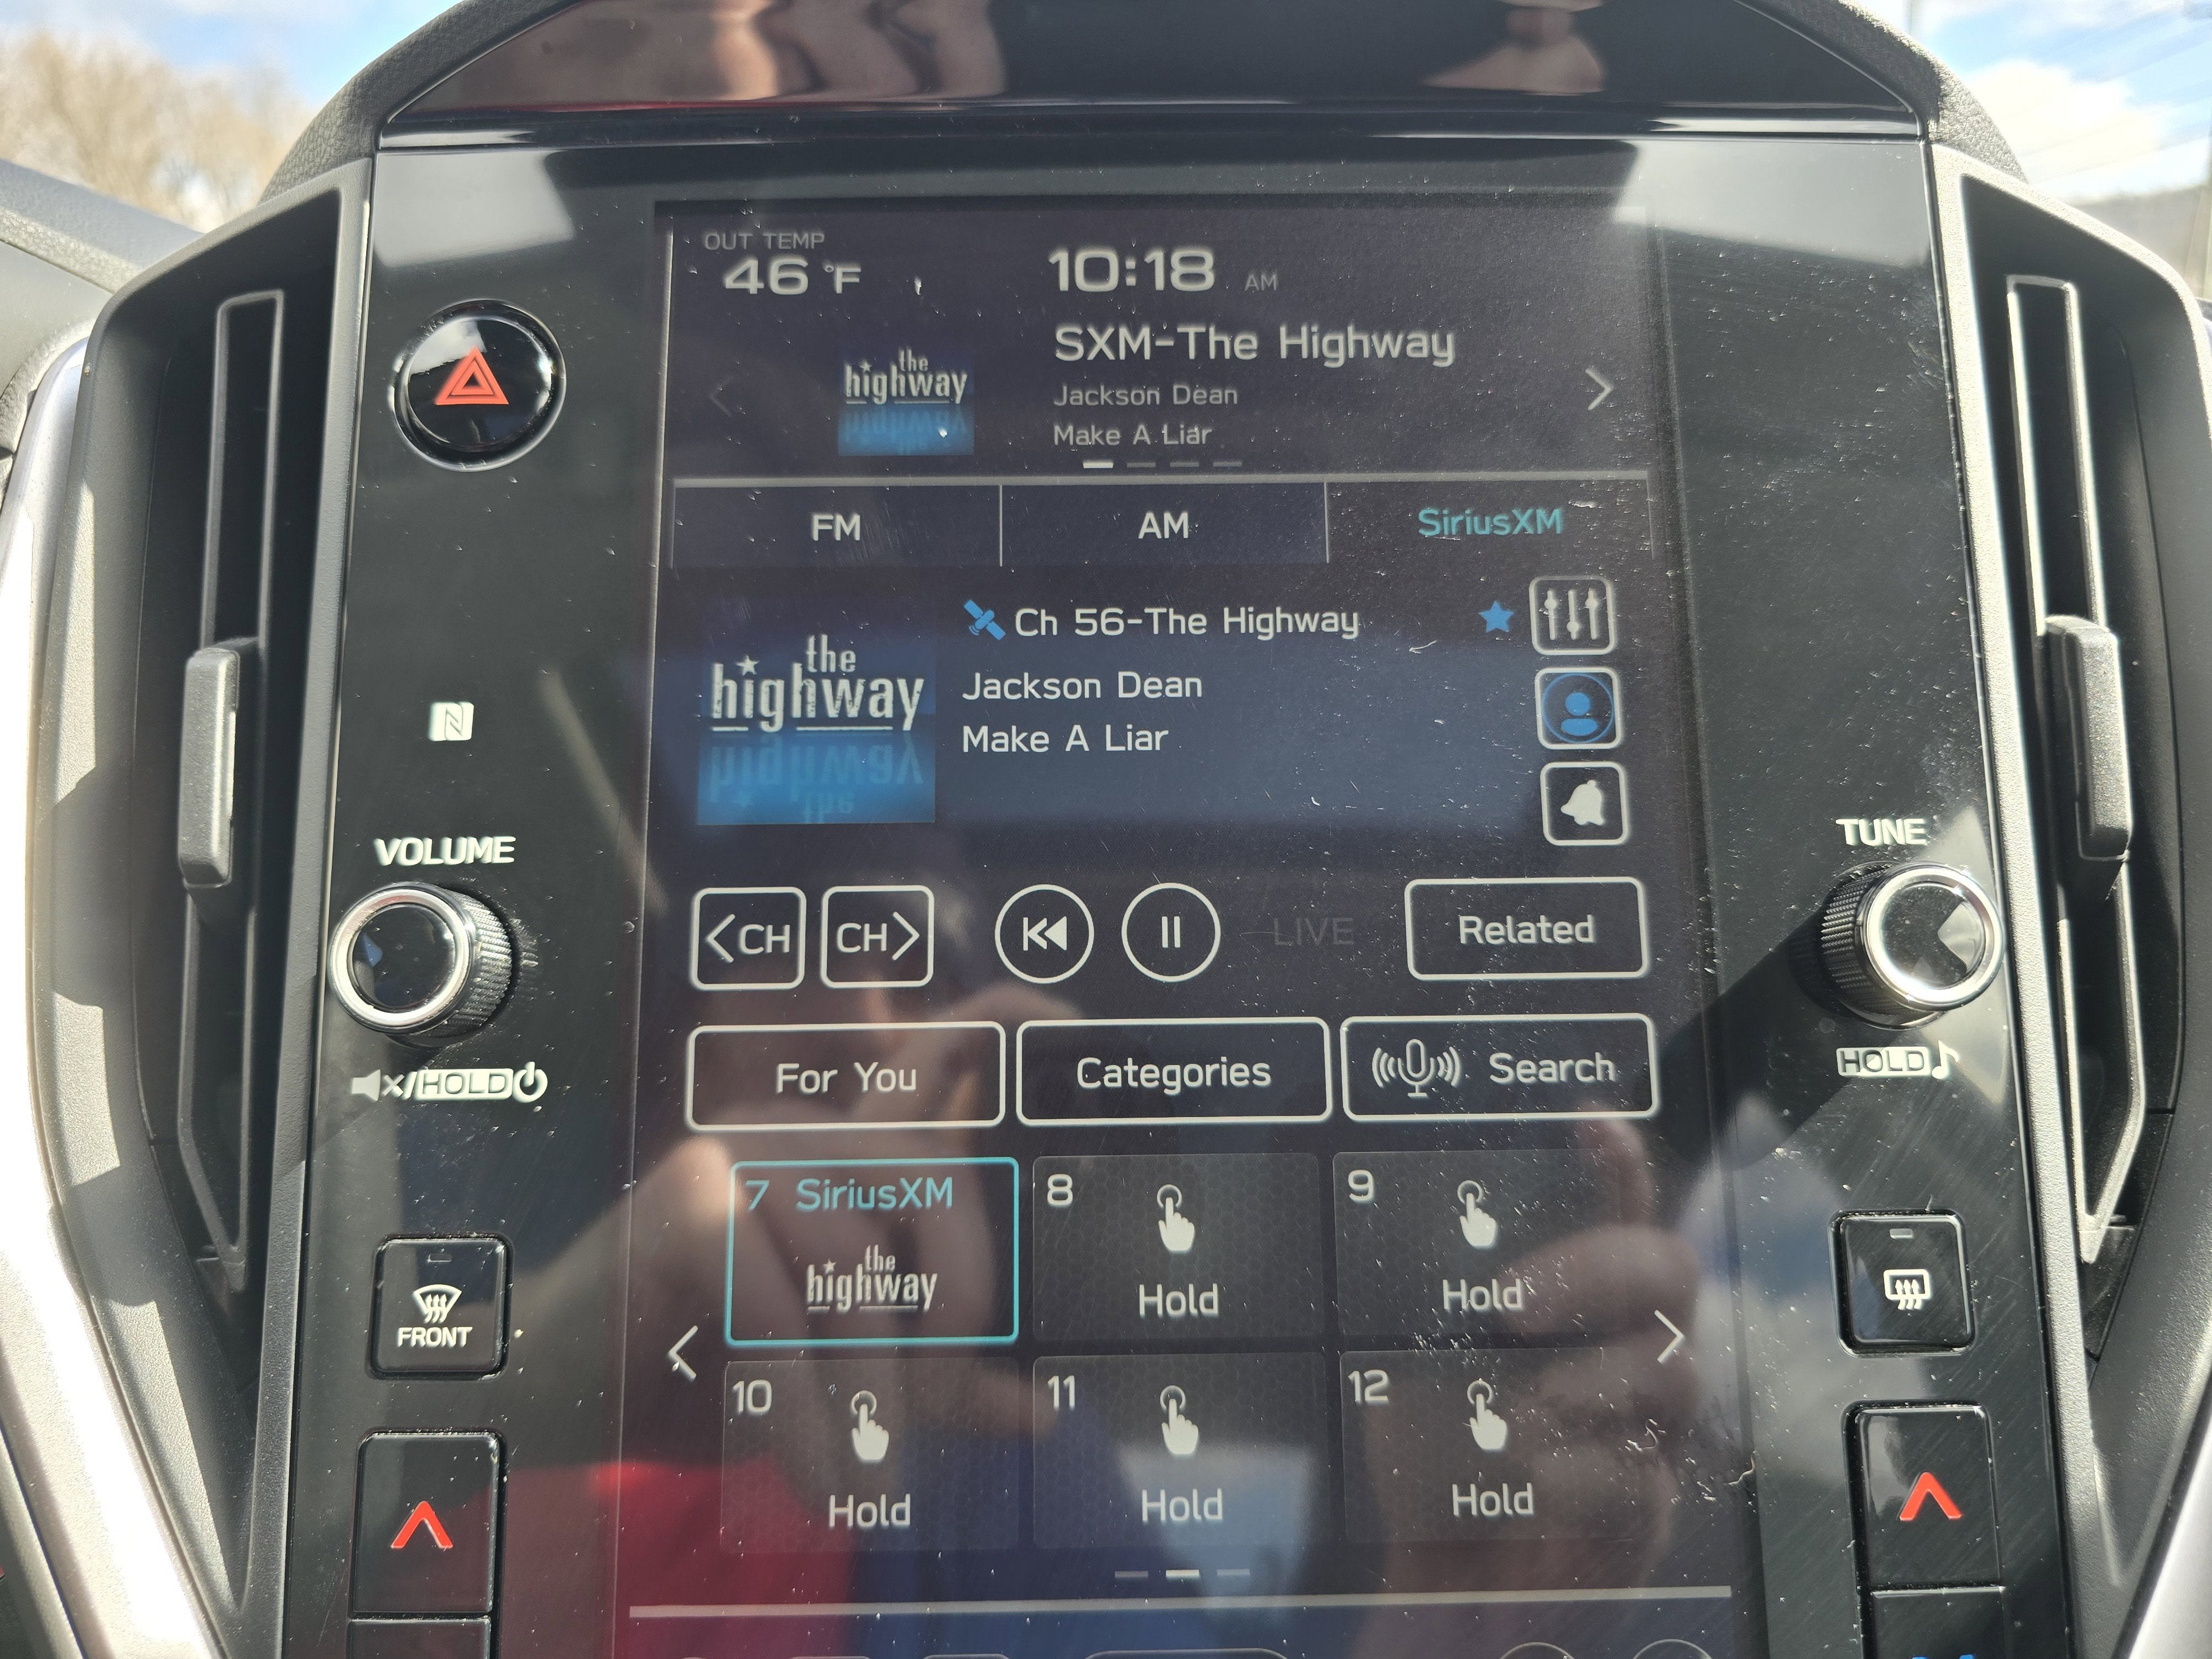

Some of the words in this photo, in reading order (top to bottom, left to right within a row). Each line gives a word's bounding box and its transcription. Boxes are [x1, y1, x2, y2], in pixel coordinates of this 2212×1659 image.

[705, 233, 753, 250] OUT
[764, 233, 825, 249] TEMP
[724, 255, 808, 295] 46
[1048, 248, 1215, 292] 10:18
[1245, 274, 1277, 291] AM
[899, 347, 928, 372] the
[1055, 324, 1258, 361] SXM-The
[1280, 324, 1455, 368] Highway
[845, 361, 967, 404] highway
[1054, 384, 1160, 405] Jackson
[1173, 384, 1238, 405] Dean
[1054, 425, 1120, 446] Make
[1133, 425, 1151, 445] A
[1163, 425, 1212, 445] Liar
[812, 514, 861, 541] FM
[1139, 513, 1189, 539] AM
[1418, 508, 1563, 538] SiriusXM
[1015, 608, 1057, 637] Ch
[1074, 607, 1207, 636] 56-The
[1223, 607, 1359, 640] Highway
[806, 634, 856, 674] the
[711, 663, 924, 731] highway
[962, 672, 1101, 701] Jackson
[1118, 671, 1202, 698] Dean
[963, 726, 1048, 753] Make
[1065, 725, 1089, 752] A
[1106, 725, 1168, 751] Liar
[1835, 819, 1927, 844] TUNE
[374, 836, 516, 865] VOLUME
[738, 924, 790, 954] CH
[836, 923, 887, 952] CH
[1274, 917, 1354, 946] LIVE
[1459, 915, 1595, 945] Related
[1077, 1057, 1271, 1095] Categories
[1489, 1052, 1615, 1083] Search
[1840, 1050, 1924, 1072] HOLD
[776, 1063, 837, 1094] For
[854, 1062, 916, 1092] You
[745, 1180, 769, 1210] 7
[796, 1177, 952, 1212] SiriusXM
[1047, 1175, 1072, 1206] 8
[1348, 1170, 1374, 1203] 9
[865, 1245, 895, 1272] the
[807, 1264, 937, 1311] highway
[1139, 1284, 1218, 1317] Hold
[1443, 1279, 1524, 1312] Hold
[398, 1327, 473, 1347] FRONT
[733, 1379, 771, 1415] 10
[1047, 1376, 1076, 1410] 11
[1349, 1370, 1389, 1404] 12
[828, 1494, 911, 1528] Hold
[1142, 1488, 1223, 1524] Hold
[1452, 1483, 1533, 1516] Hold
